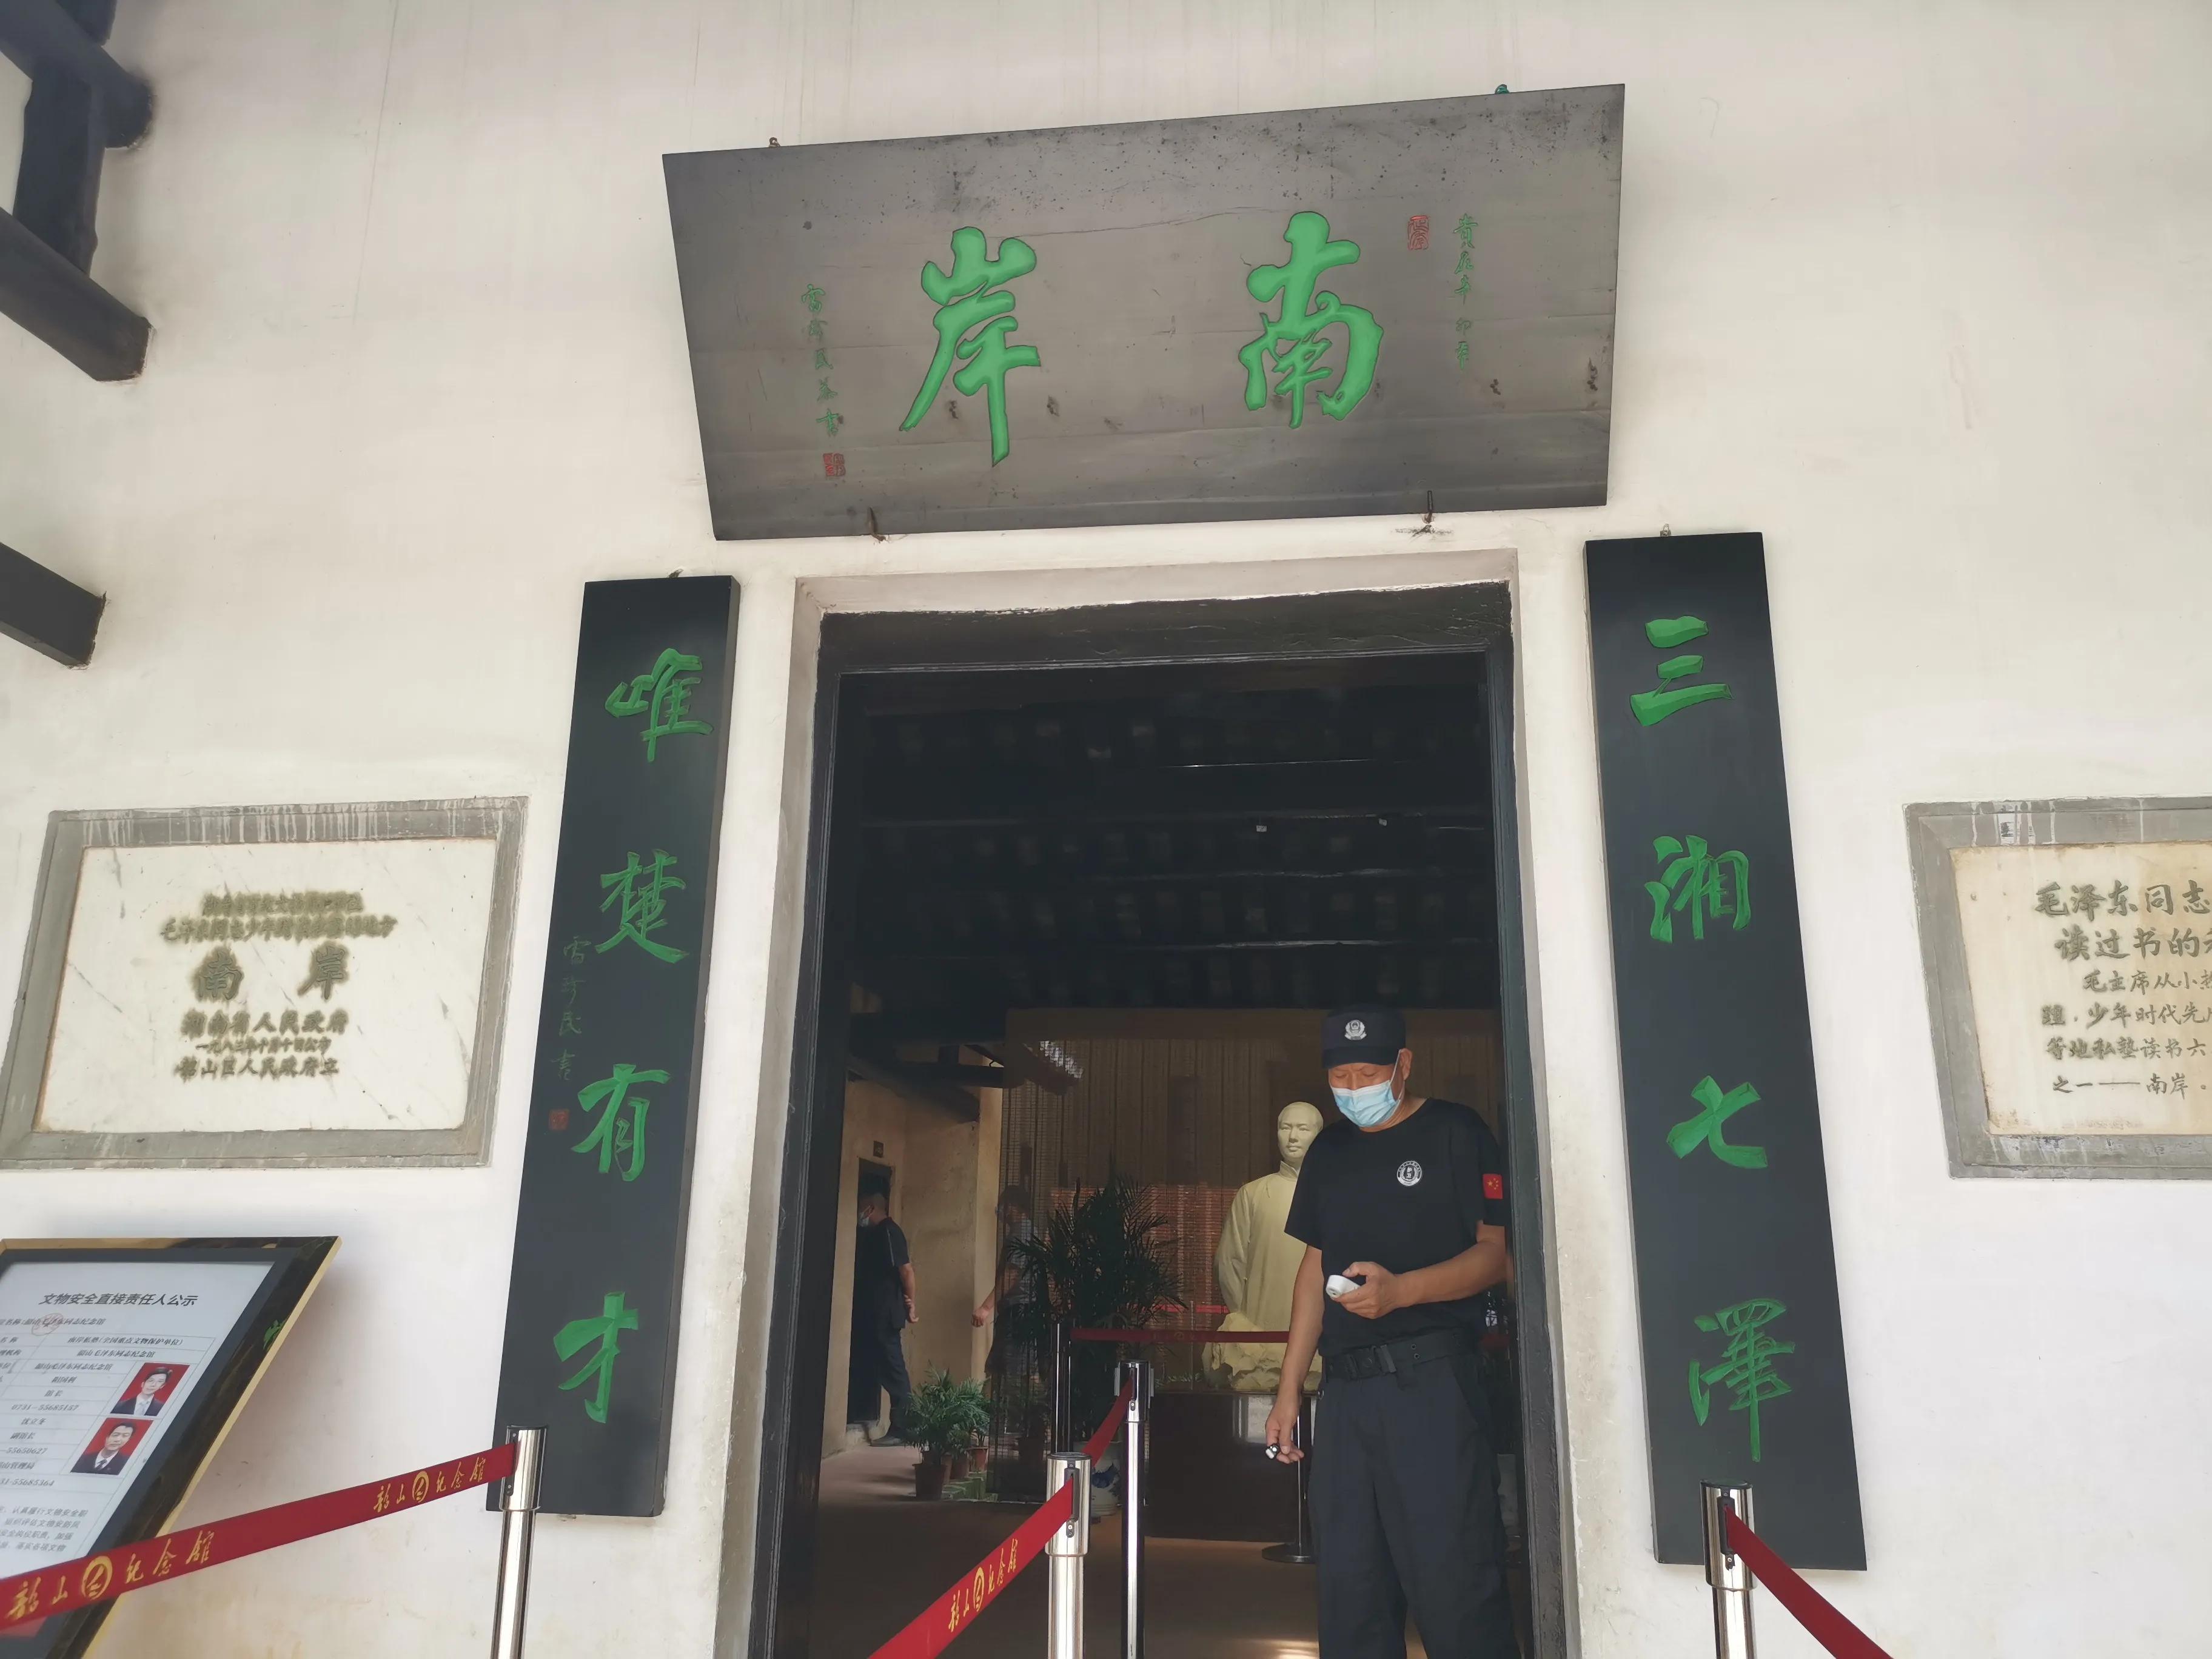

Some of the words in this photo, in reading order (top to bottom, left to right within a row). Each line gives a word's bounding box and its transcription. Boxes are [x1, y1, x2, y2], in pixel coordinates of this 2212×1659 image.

[899, 210, 1384, 464] 南岸
[2034, 879, 2211, 922] 毛泽东同志
[2054, 924, 2212, 962] 读过书的
[190, 942, 349, 1002] 南岸
[181, 1008, 349, 1039] 湖南省人民政府
[38, 1293, 199, 1307] 文物安全直接责任人公示
